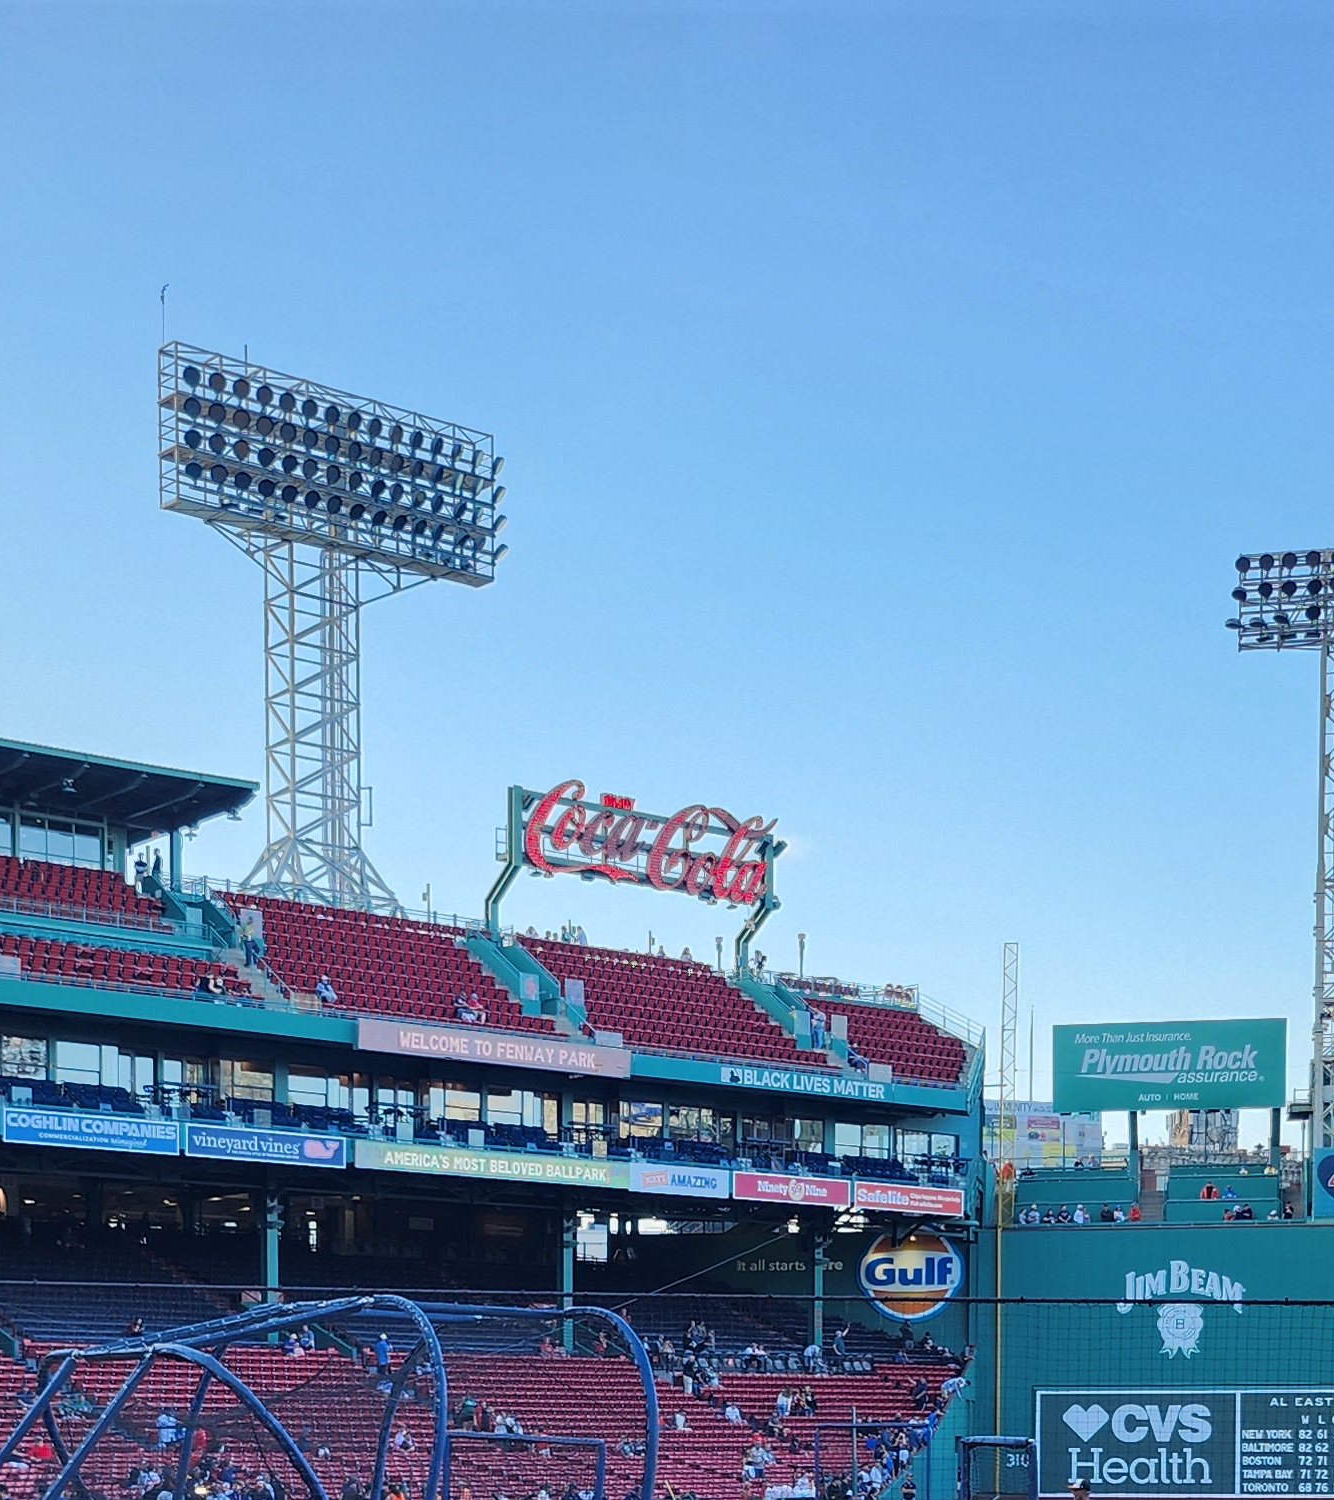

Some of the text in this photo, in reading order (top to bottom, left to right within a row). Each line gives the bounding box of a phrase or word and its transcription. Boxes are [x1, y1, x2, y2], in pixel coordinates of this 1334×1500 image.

[1075, 1032, 1192, 1045] More Than Just Insurance.
[399, 1030, 596, 1070] WELCOME TO FENWAY PARK
[1081, 1045, 1258, 1076] Plymouth Rock
[1177, 1060, 1259, 1083] assurance
[743, 1069, 885, 1100] BLACK LIVES MATTER
[1138, 1093, 1199, 1102] AUTO HOME
[7, 1113, 177, 1141] COGHLIN COMPANIES
[38, 1132, 109, 1144] COMMERCIALIZATION
[192, 1132, 301, 1154] vineyard vines
[384, 1151, 607, 1182] AMERICA'S MOST BELOVED BALLPARK
[757, 1180, 828, 1198] Ninety Nine
[857, 1188, 910, 1206] Safelite
[749, 1259, 806, 1272] all starts
[864, 1256, 953, 1287] Gulf
[1117, 1260, 1244, 1315] JIM BEAM
[1269, 1397, 1334, 1407] AL EAST
[1111, 1404, 1213, 1443] CVS
[1301, 1415, 1309, 1425] W
[1318, 1415, 1326, 1425] L
[1242, 1429, 1313, 1439] NEW YORK 82
[1242, 1443, 1313, 1453] BALTIMORE 82
[1005, 1453, 1030, 1468] 310
[1068, 1447, 1213, 1485] Health
[1242, 1456, 1282, 1466] BOSTON
[1242, 1469, 1294, 1479] TAMPA BAY
[1242, 1482, 1289, 1492] TORONTO
